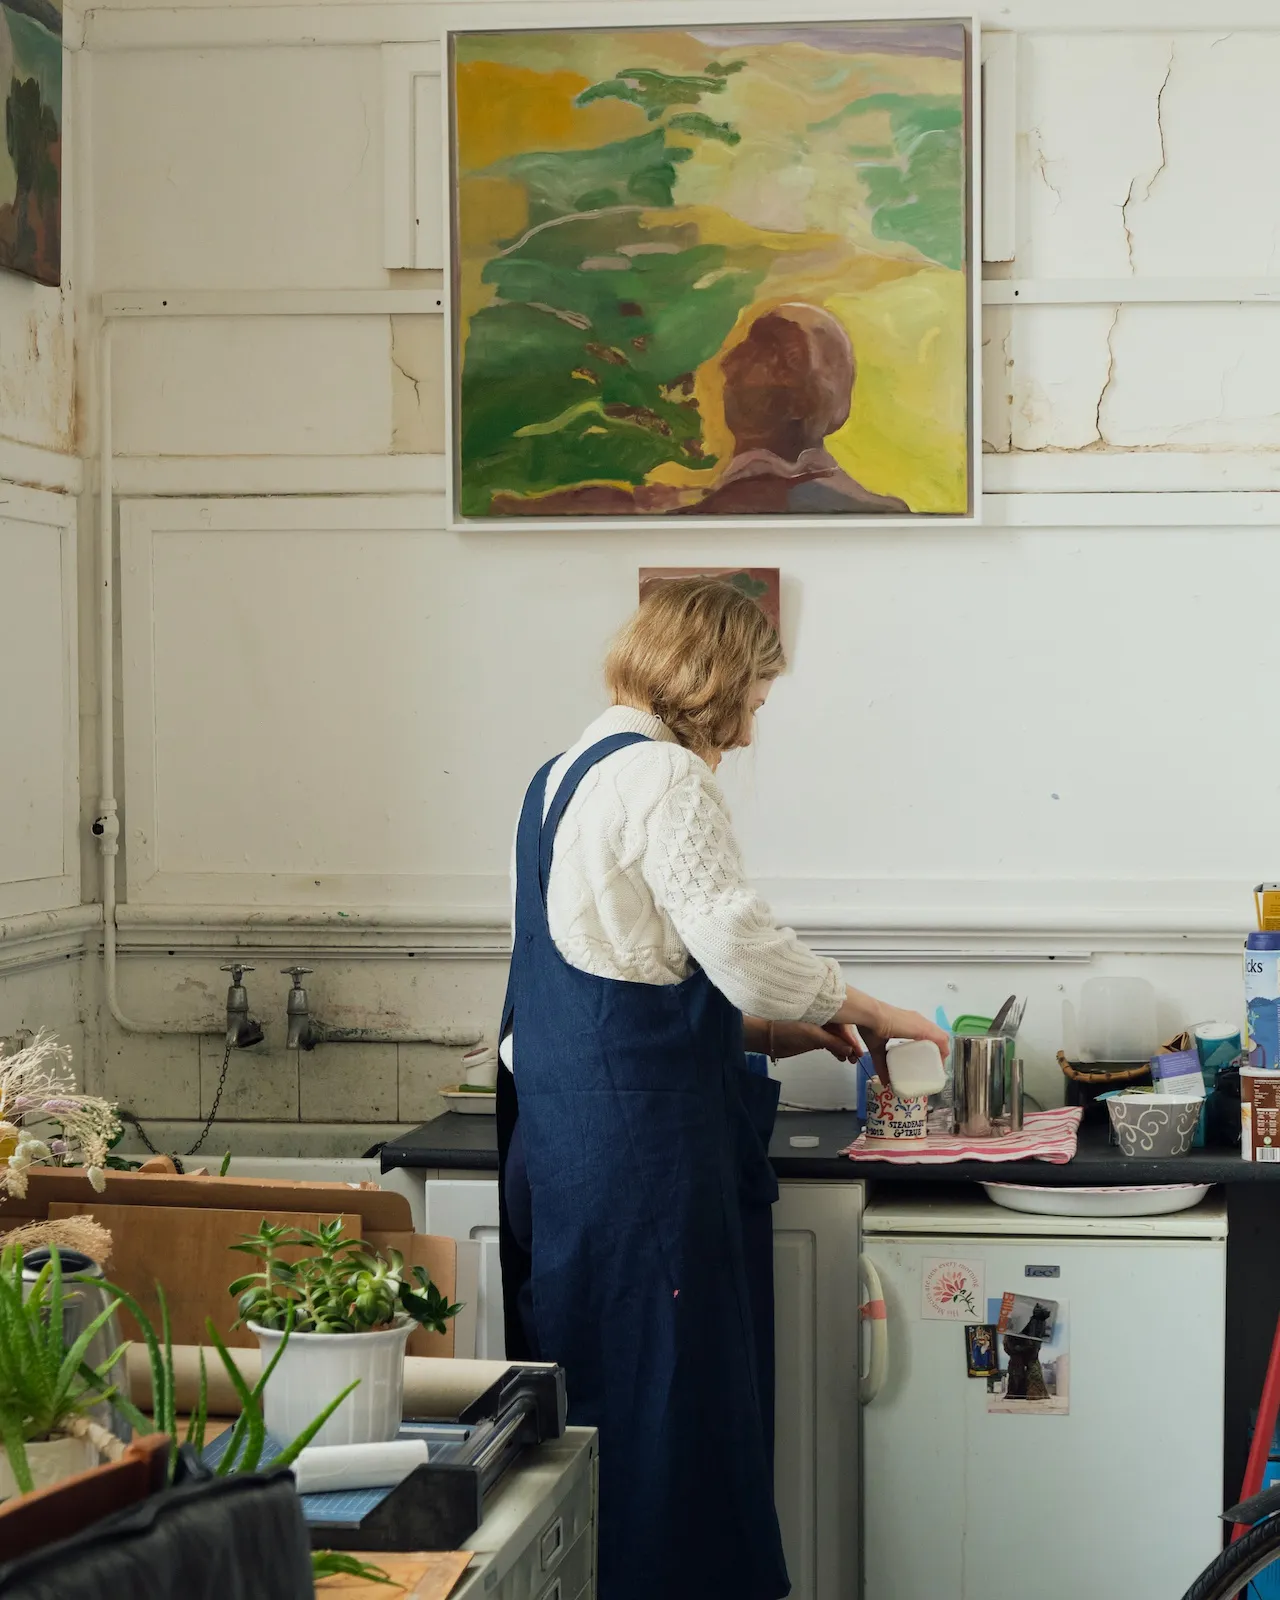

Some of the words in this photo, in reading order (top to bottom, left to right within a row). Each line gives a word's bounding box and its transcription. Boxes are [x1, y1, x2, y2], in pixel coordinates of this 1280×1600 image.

[888, 1120, 926, 1129] STEADFAST
[905, 1129, 922, 1137] TRUE
[938, 1261, 957, 1269] every
[958, 1263, 980, 1288] morning
